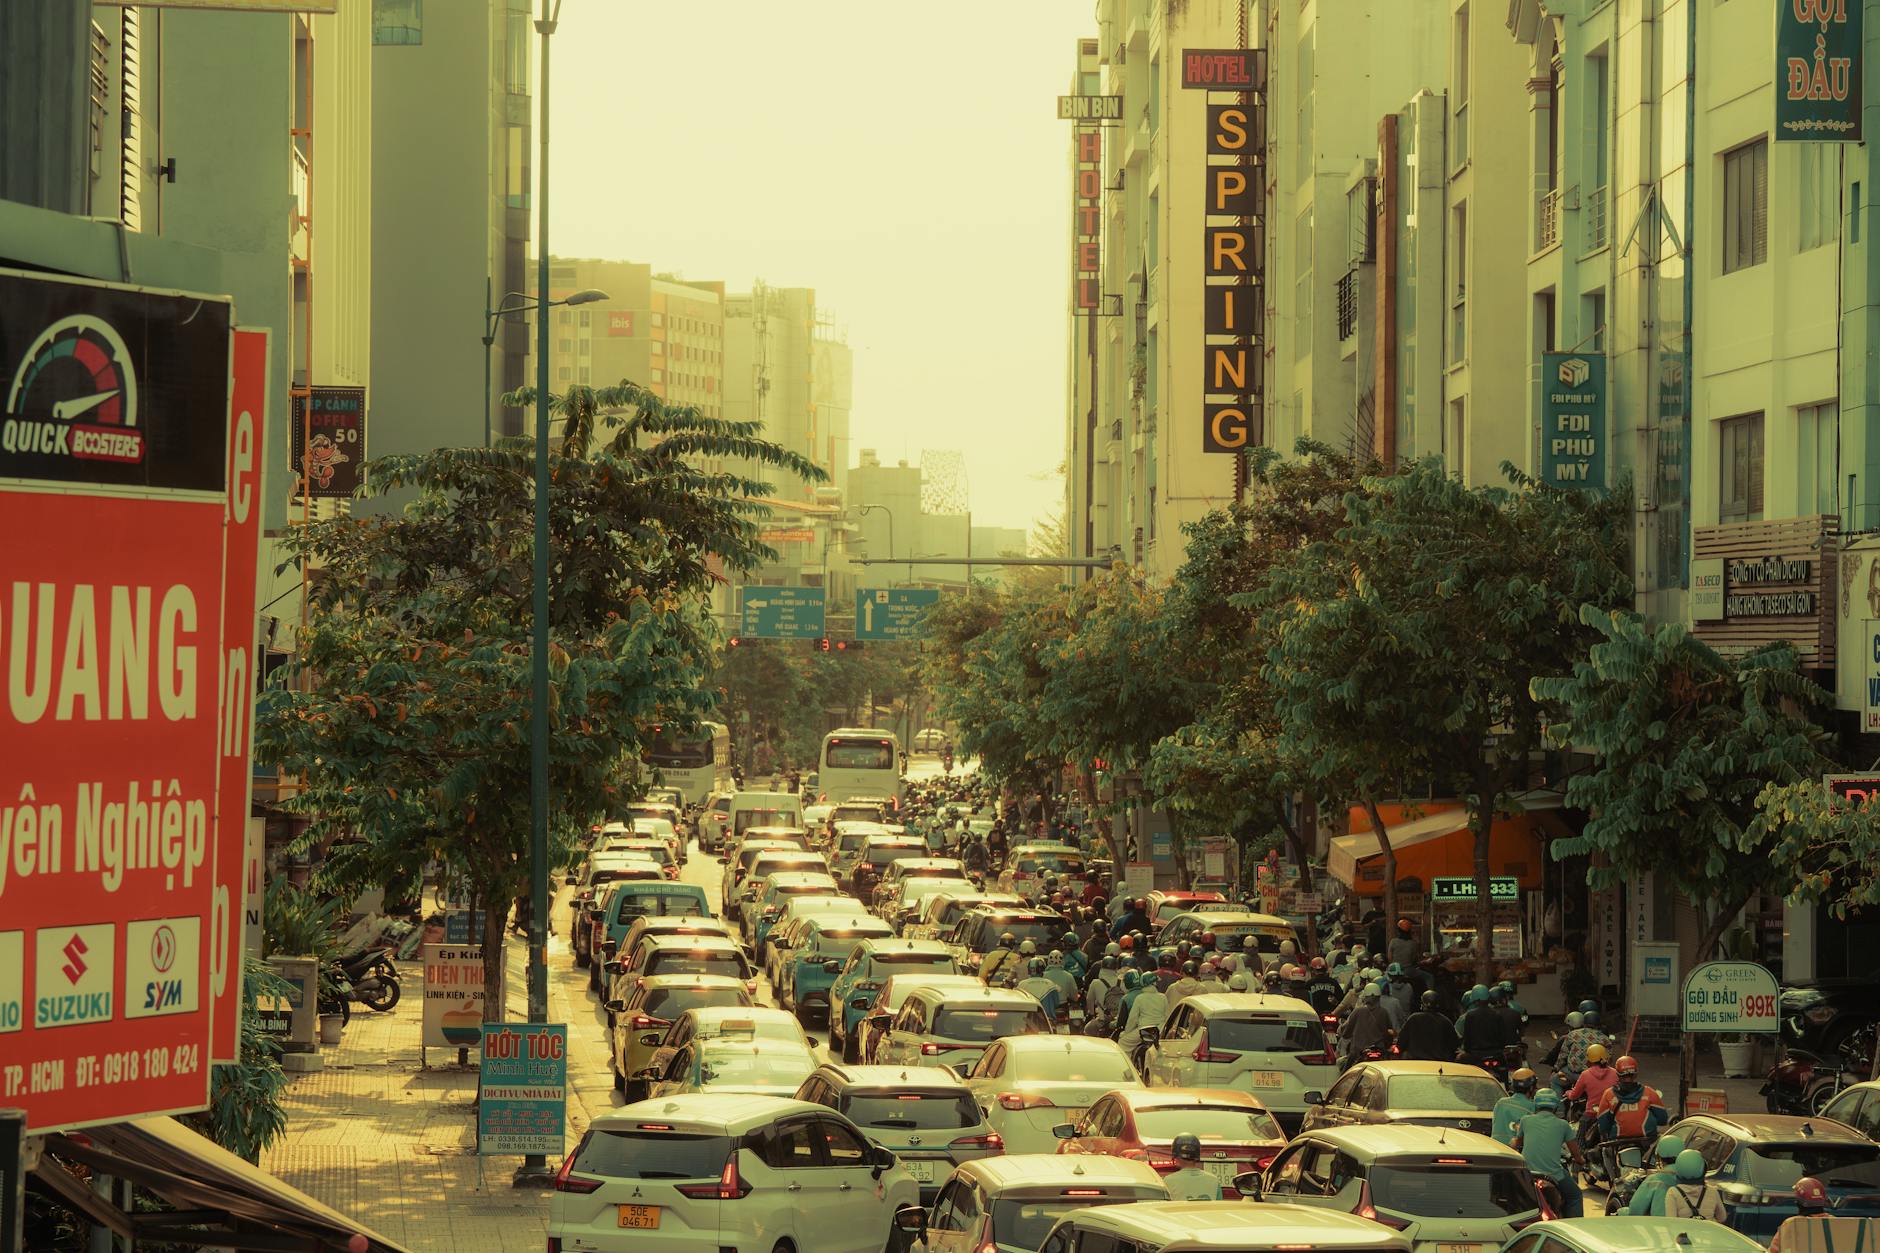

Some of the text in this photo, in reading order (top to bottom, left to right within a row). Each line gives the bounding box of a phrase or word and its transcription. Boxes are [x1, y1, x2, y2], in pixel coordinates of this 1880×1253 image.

[1187, 55, 1250, 82] HOTEL
[1787, 33, 1851, 101] ĐẦU
[1061, 97, 1118, 118] BIN BIN
[1079, 132, 1100, 309] HOTEL
[1211, 109, 1248, 448] SPRING
[610, 317, 631, 330] ibis
[335, 428, 358, 443] 50
[1557, 414, 1590, 432] FDI
[2, 420, 141, 459] QUICK BOOSTERS
[1551, 434, 1595, 456] PHÚ
[1556, 459, 1590, 481] MỸ
[75, 778, 206, 892] Nghiệp
[427, 961, 459, 988] ĐIỆN
[1725, 969, 1756, 977] GREEN
[143, 979, 182, 1010] SYM
[426, 991, 445, 999] LINH
[1688, 984, 1738, 1008] GỘI ĐẦU
[1745, 995, 1776, 1017] 99K
[37, 992, 110, 1023] SUZUKI
[1719, 1011, 1739, 1022] SINH
[485, 1027, 563, 1060] HỚT TÓC
[4, 1043, 199, 1097] TP. HCM ĐT: 0918 180 424
